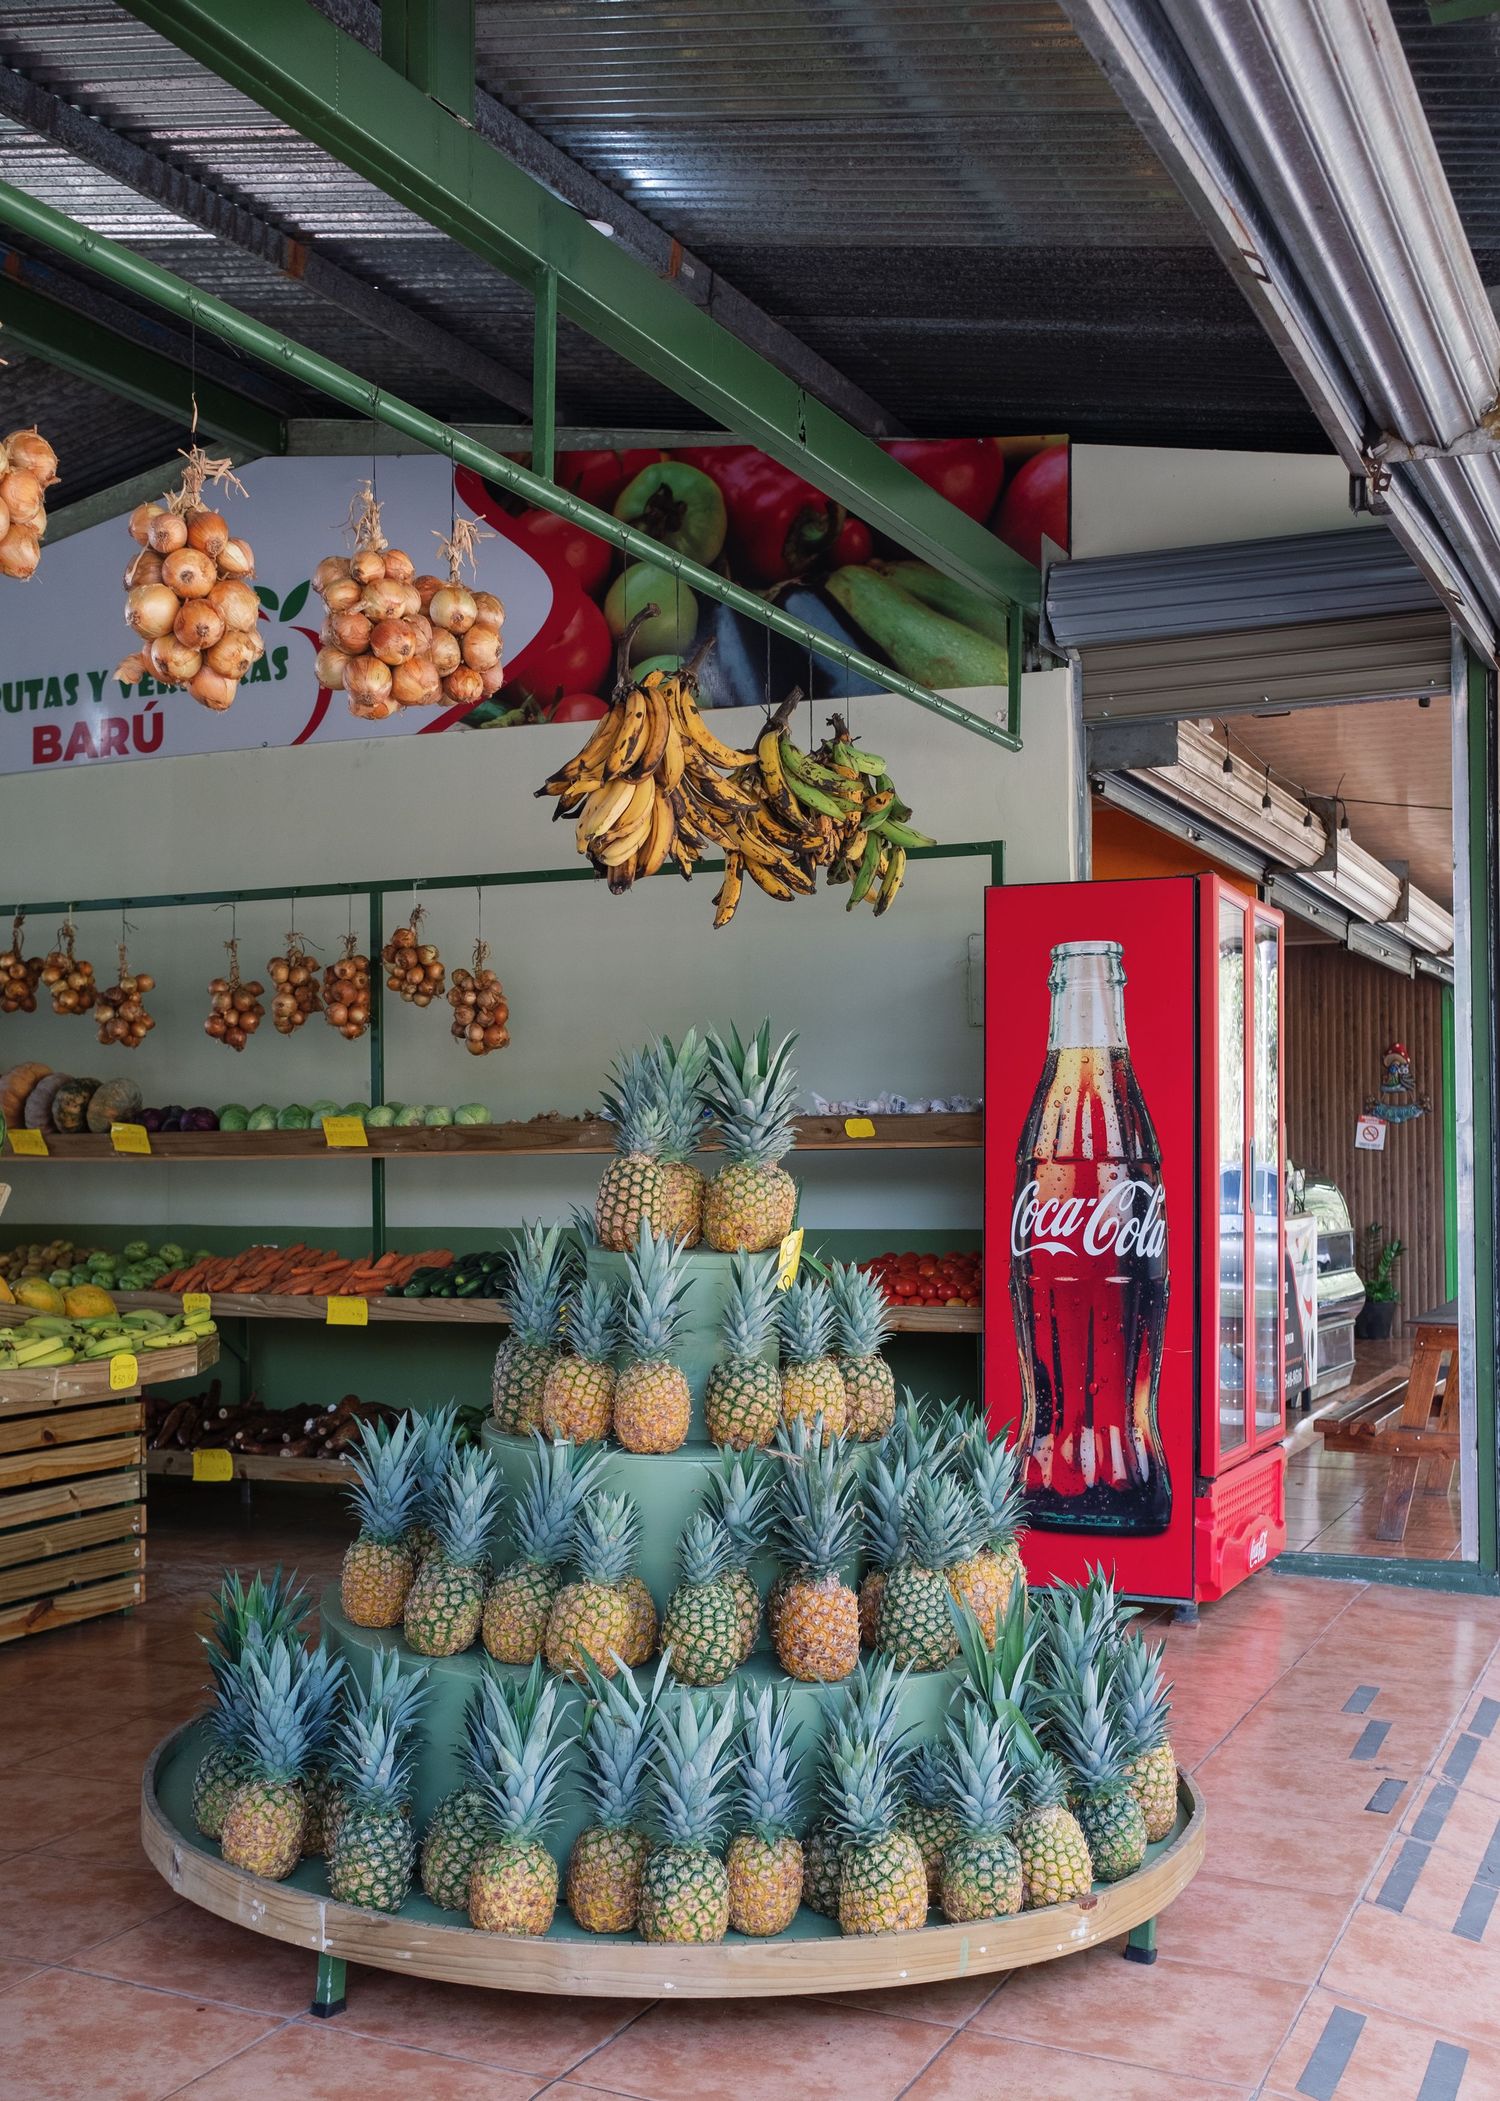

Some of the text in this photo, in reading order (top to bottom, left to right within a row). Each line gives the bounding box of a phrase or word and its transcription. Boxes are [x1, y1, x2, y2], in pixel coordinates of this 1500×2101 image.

[0, 672, 79, 713] UTAS
[86, 669, 109, 703] Y
[32, 700, 164, 765] BARÚ
[1010, 1179, 1166, 1258] Coca-Cola
